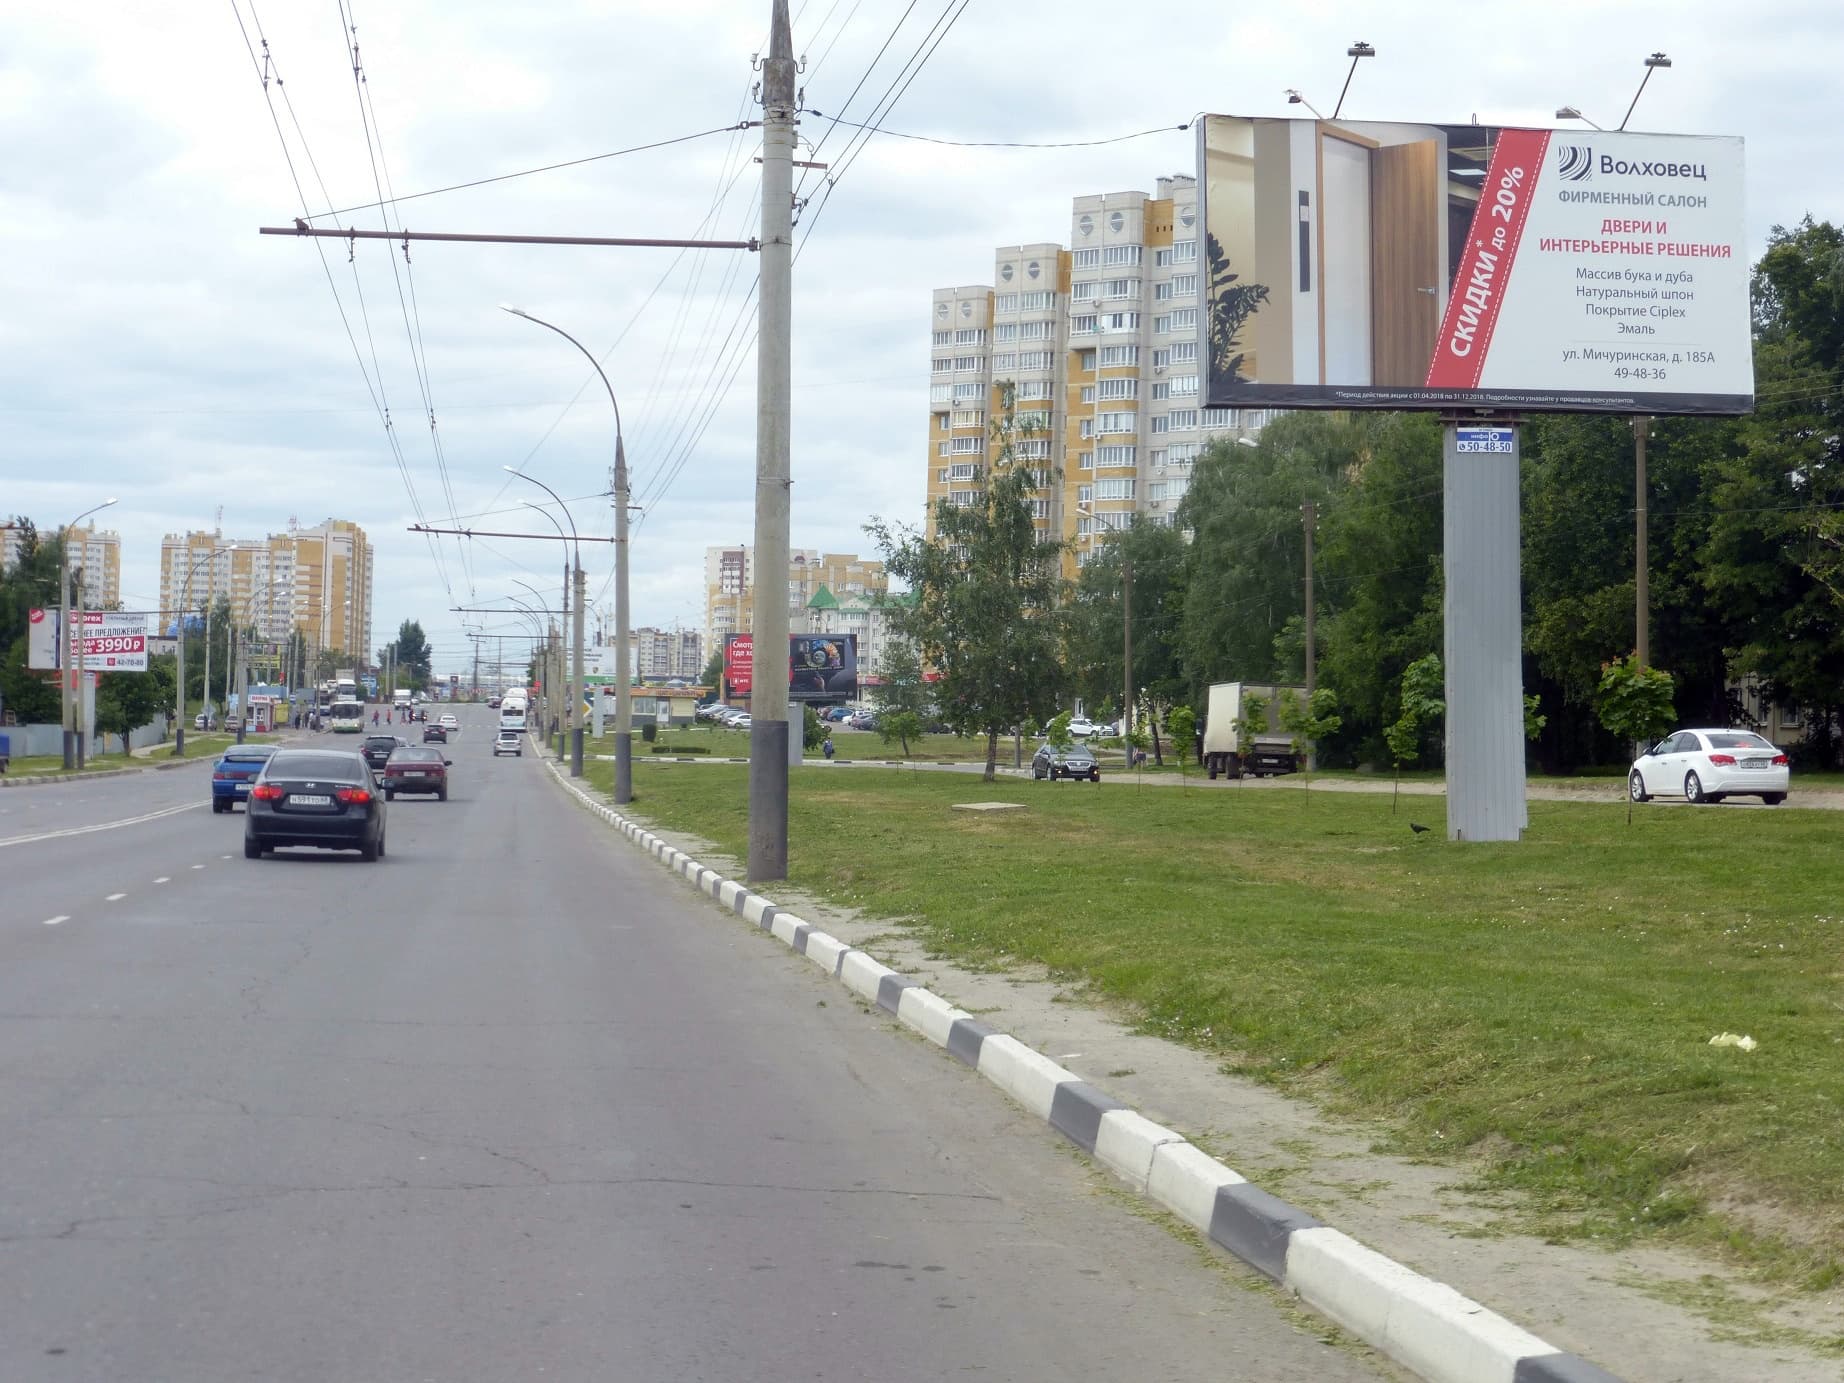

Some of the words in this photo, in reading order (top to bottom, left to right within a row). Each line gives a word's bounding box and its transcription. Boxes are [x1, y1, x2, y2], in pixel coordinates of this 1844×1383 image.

[1600, 155, 1707, 181] Волховец
[1491, 166, 1524, 223] 20%
[1558, 190, 1655, 206] ФИРМЕННЫЙ
[1657, 194, 1707, 208] САЛОН
[1601, 219, 1652, 235] ДВЕРИ
[1656, 221, 1667, 234] И
[1491, 226, 1506, 251] до
[1540, 238, 1654, 256] ИНТЕРЬЕРНЫЕ
[1657, 242, 1731, 258] РЕШЕНИЯ
[1576, 267, 1622, 280] Массив
[1624, 268, 1652, 283] бука
[1655, 272, 1662, 281] и
[1665, 271, 1693, 285] дуба
[1576, 285, 1658, 300] Натуральный
[1661, 289, 1694, 301] шпон
[1586, 303, 1648, 318] Покрытие
[1649, 305, 1686, 320] Ciplex
[1617, 322, 1656, 335] Эмаль
[1562, 349, 1580, 362] ул.
[1583, 348, 1669, 363] Мичуринская,
[1672, 352, 1683, 363] д.
[1614, 367, 1667, 380] 49-48-36
[1467, 441, 1511, 452] 50-48-50
[96, 638, 132, 653] 3990
